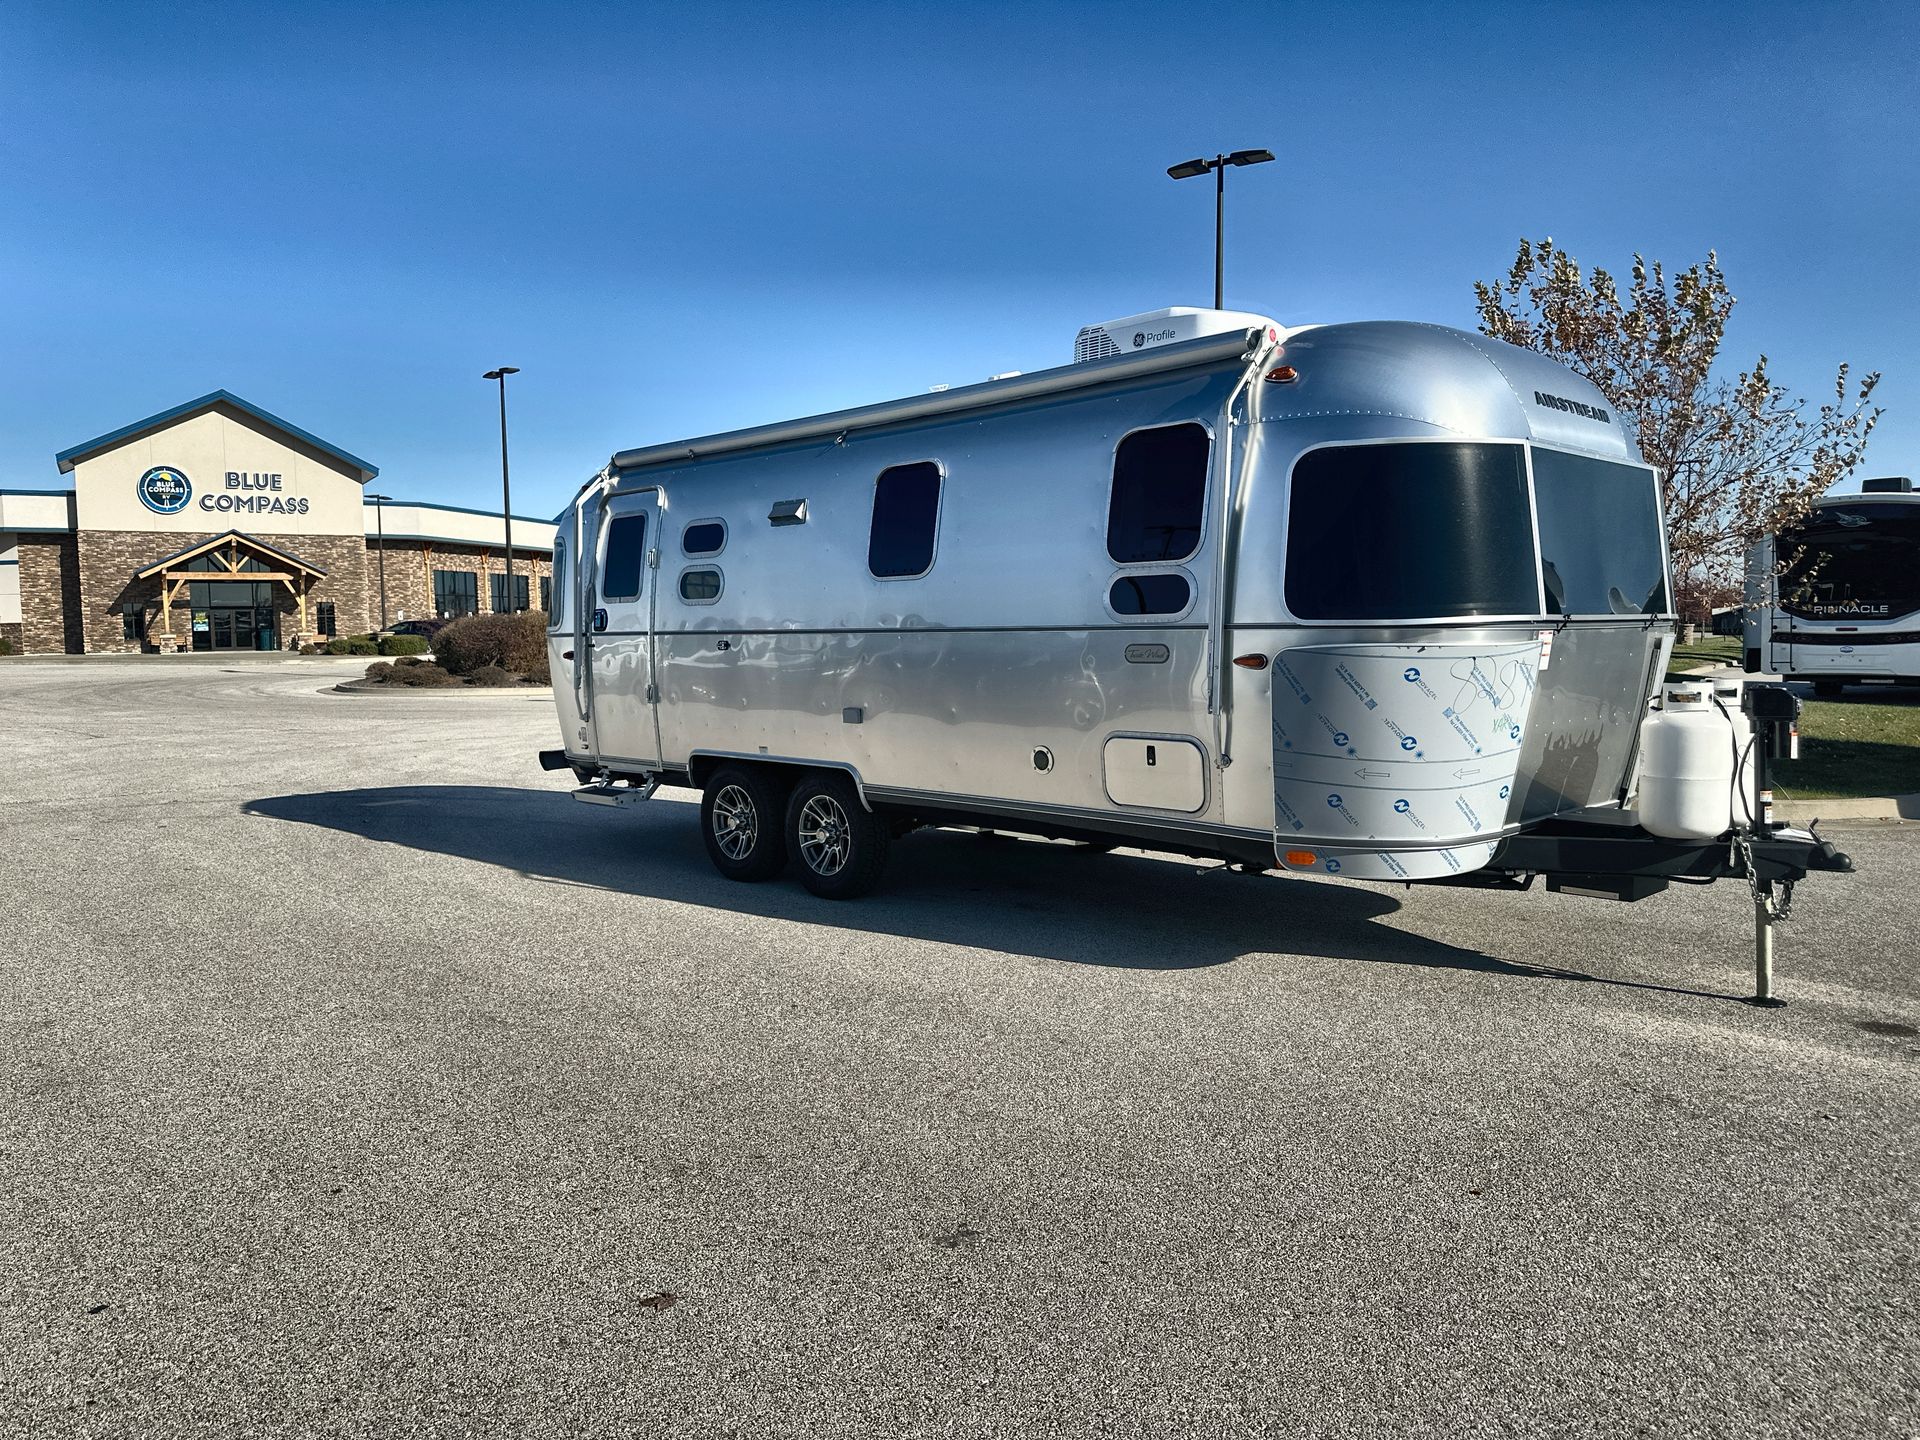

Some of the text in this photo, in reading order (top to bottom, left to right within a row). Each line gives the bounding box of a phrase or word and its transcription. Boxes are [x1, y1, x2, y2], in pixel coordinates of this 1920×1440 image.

[1146, 328, 1176, 344] Profile
[1534, 390, 1611, 424] AIRSTREAM
[225, 472, 283, 491] BLUE
[199, 494, 309, 514] COMPASS
[1813, 605, 1889, 614] PINNACLE
[1417, 678, 1437, 700] NOVACEL
[1382, 718, 1403, 739] NOVACEL
[1406, 809, 1426, 830] NOVACEL
